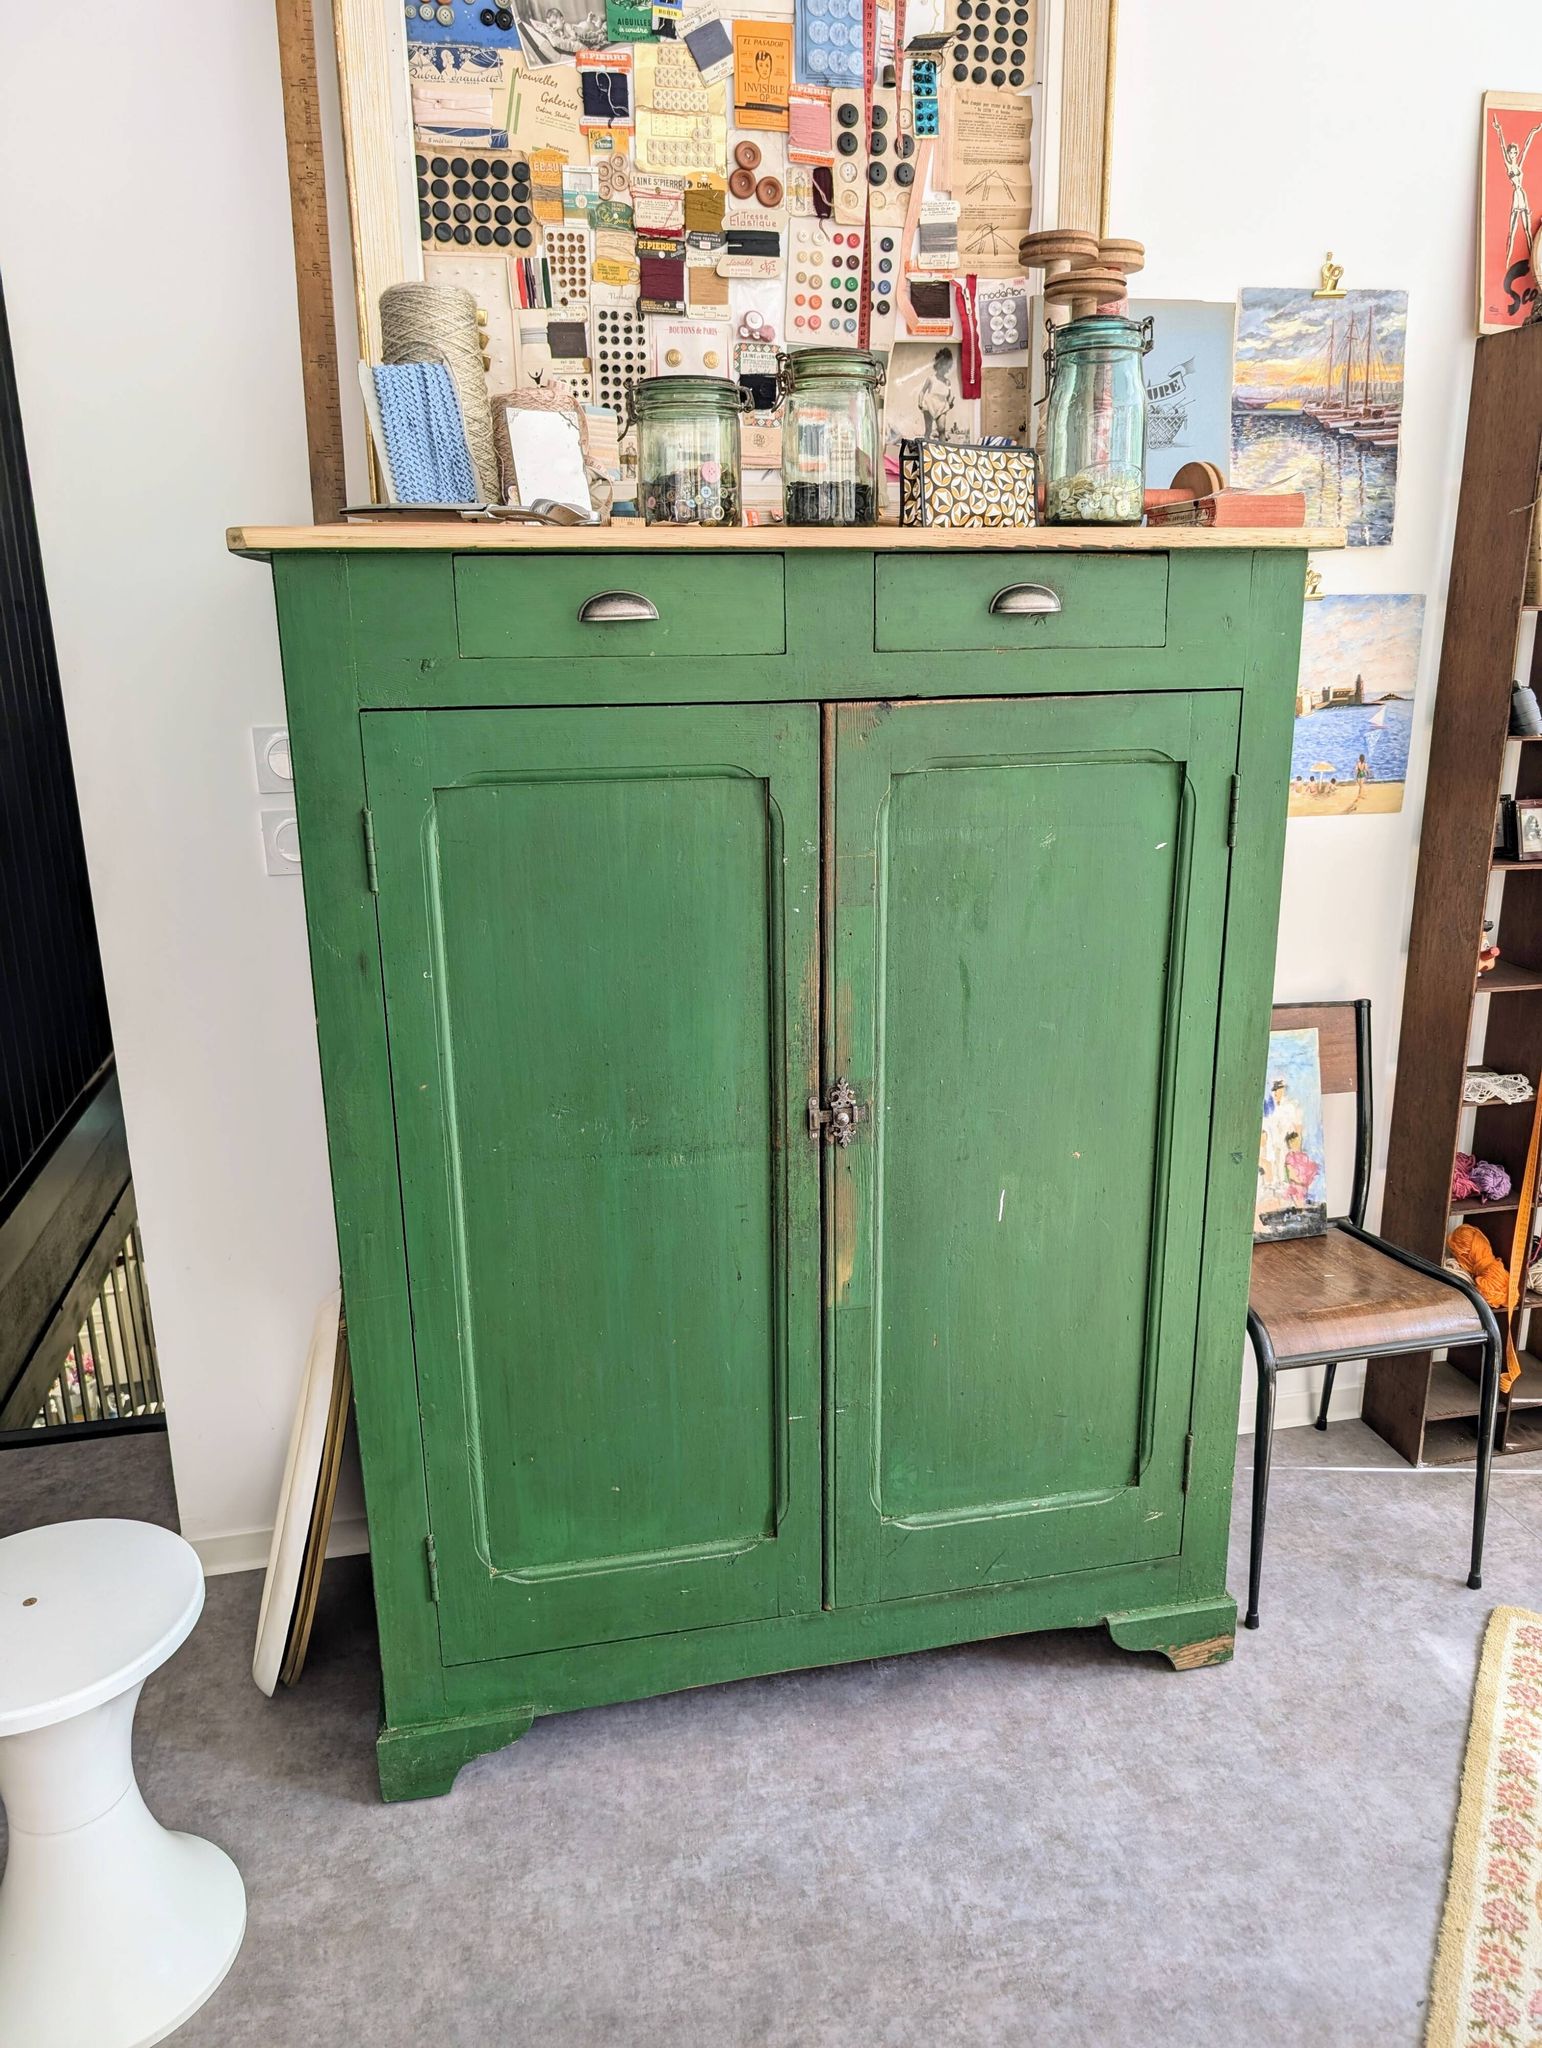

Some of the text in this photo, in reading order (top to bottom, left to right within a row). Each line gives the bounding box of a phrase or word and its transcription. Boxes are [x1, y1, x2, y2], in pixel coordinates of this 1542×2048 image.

[753, 39, 784, 48] PASADOR
[514, 67, 559, 89] Nouvelles
[743, 82, 785, 95] INVISIBLE
[540, 91, 578, 111] Galeries
[633, 176, 652, 185] LAINE
[696, 181, 713, 190] DMC
[740, 211, 769, 220] Tresse
[646, 241, 677, 252] PIERRE
[979, 287, 1026, 300] modaflor
[668, 326, 696, 335] BOUTONS
[702, 327, 718, 335] PARIS
